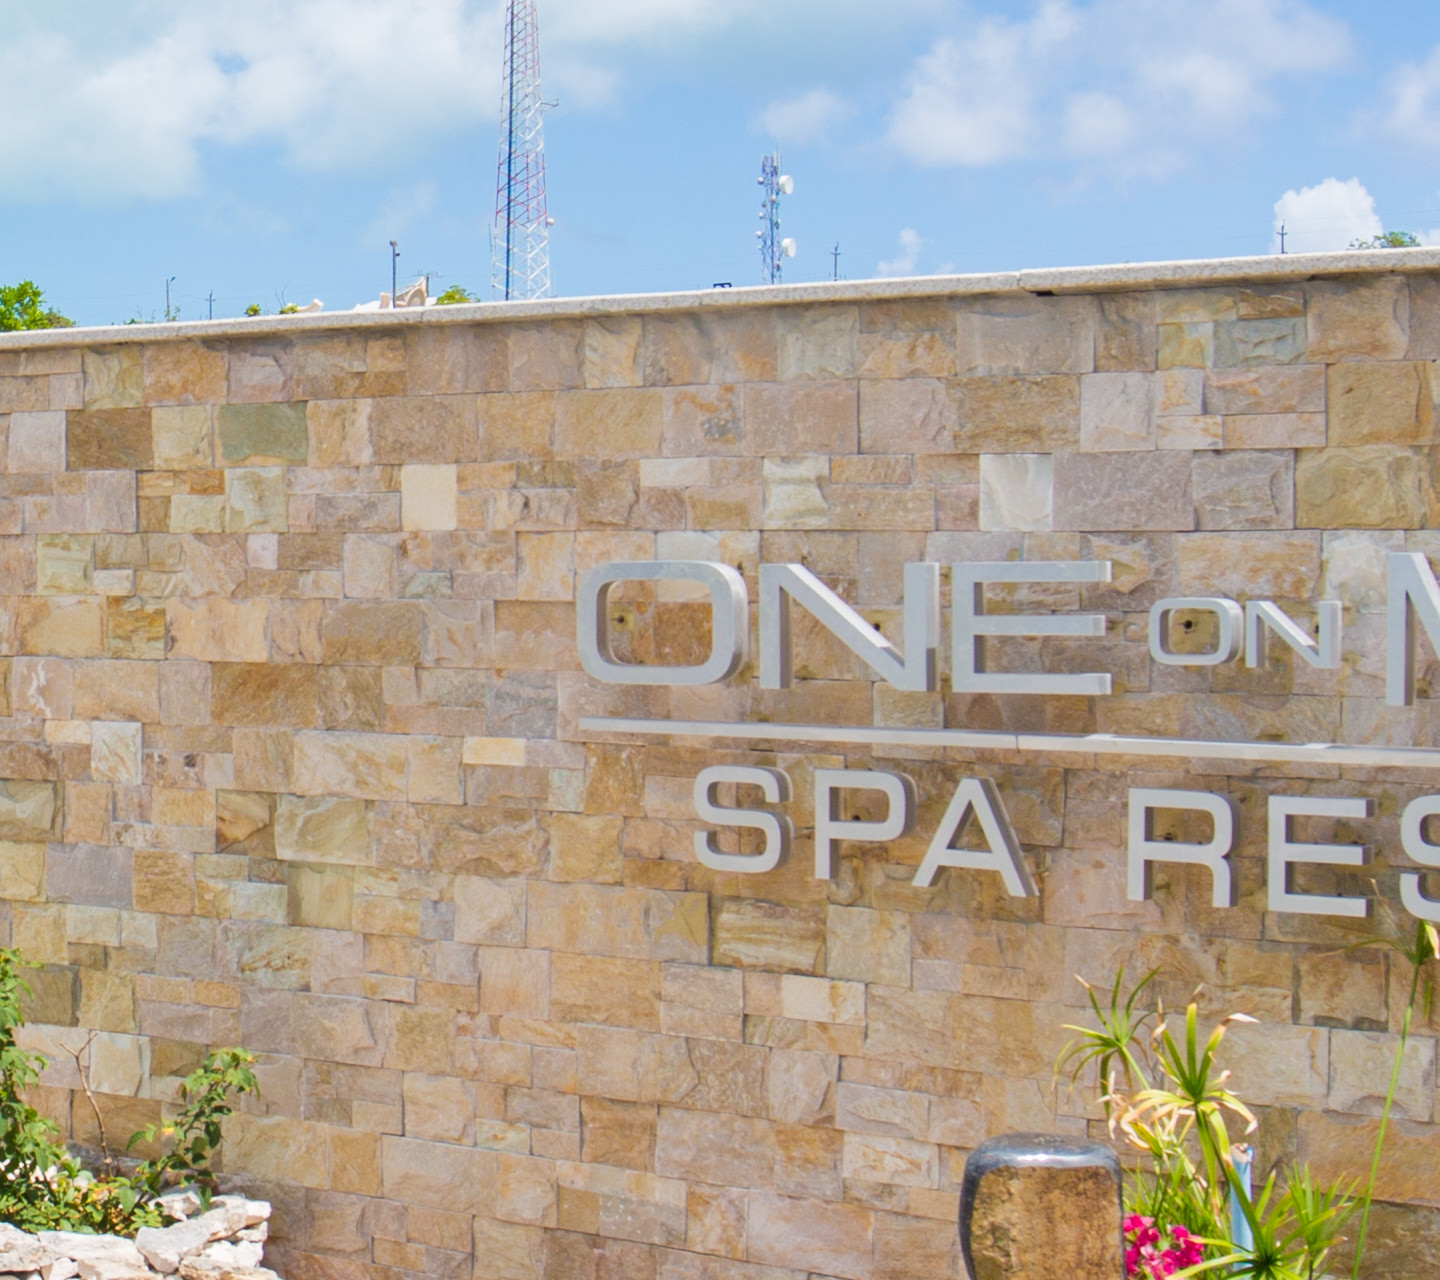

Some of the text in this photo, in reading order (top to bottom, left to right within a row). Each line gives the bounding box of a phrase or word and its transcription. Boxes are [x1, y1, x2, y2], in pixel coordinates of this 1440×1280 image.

[577, 560, 1112, 696] ONE
[1148, 597, 1342, 669] ON
[692, 765, 1040, 898] SPA
